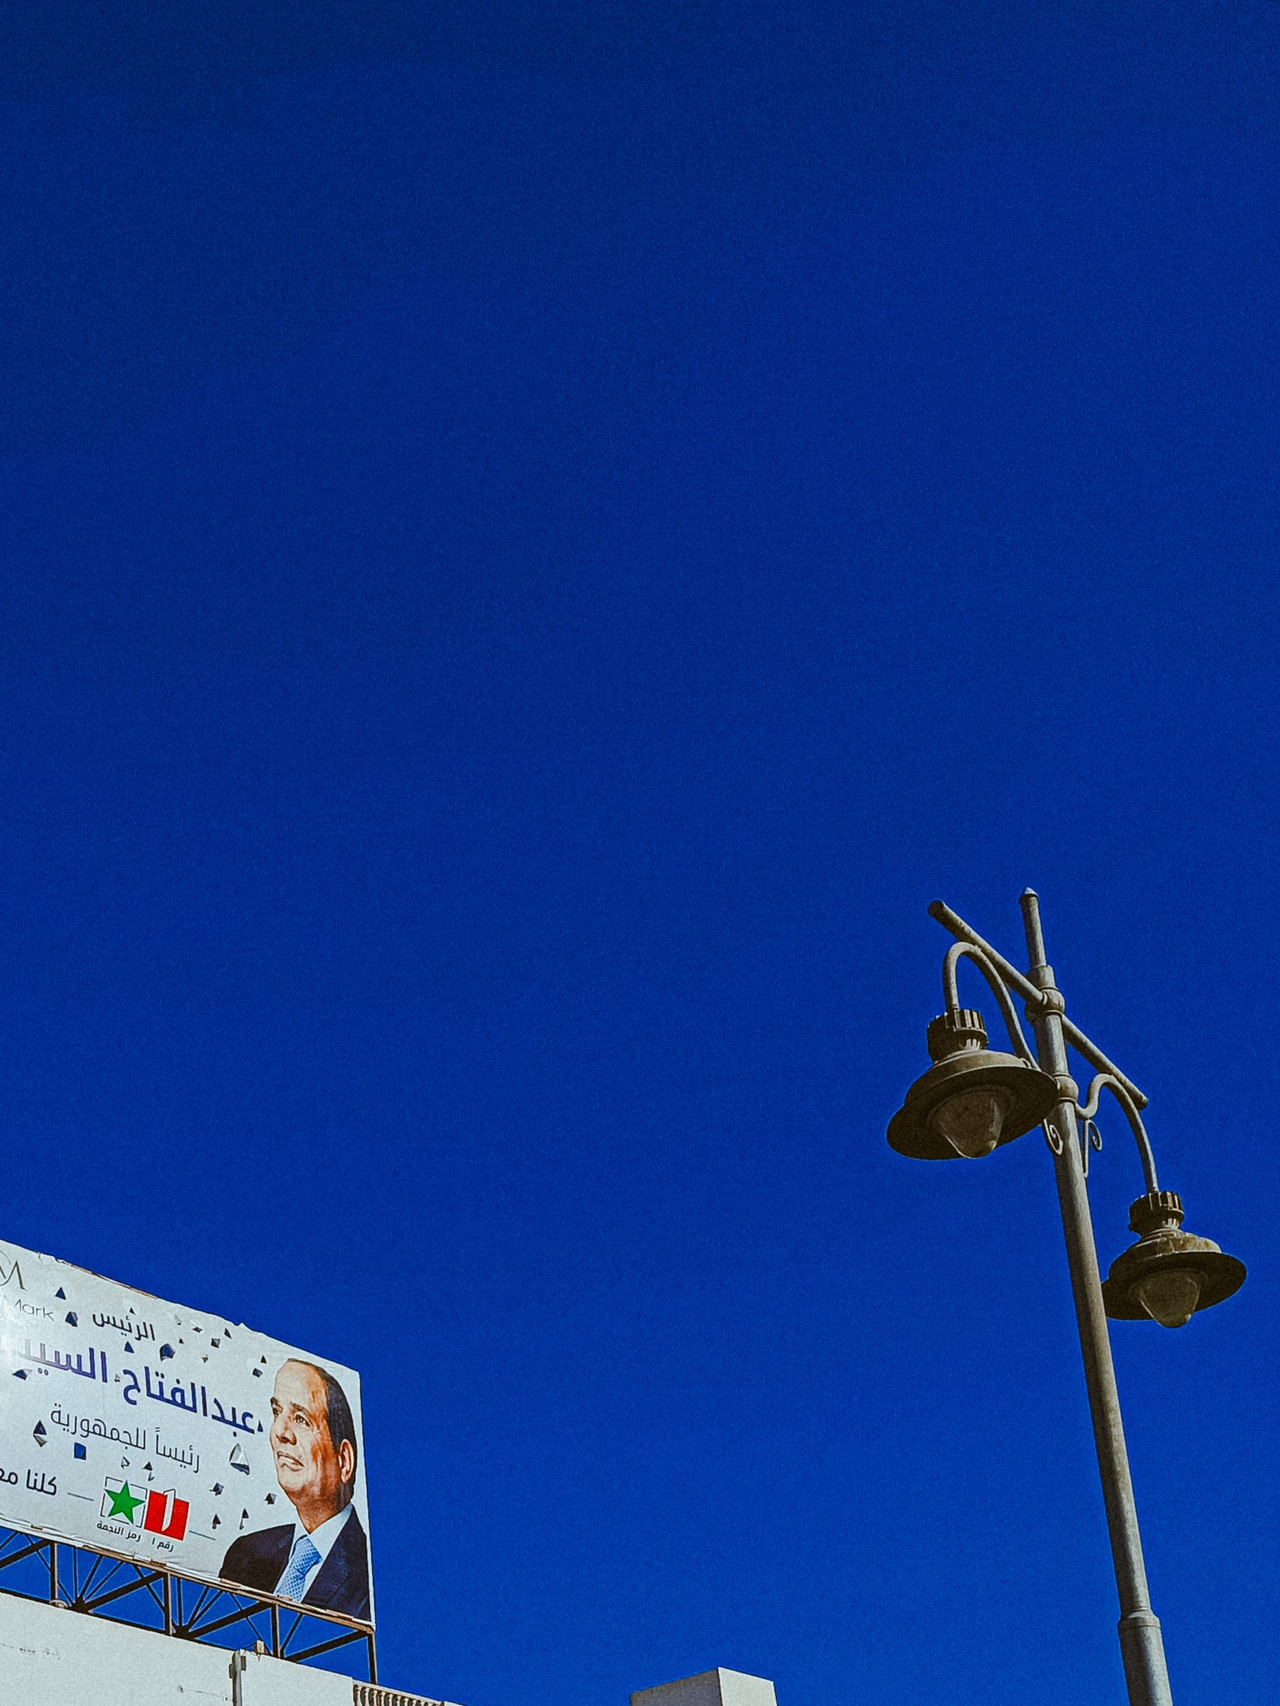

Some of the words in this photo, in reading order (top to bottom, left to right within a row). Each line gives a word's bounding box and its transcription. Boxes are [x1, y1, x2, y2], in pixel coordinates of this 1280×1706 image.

[93, 1311, 156, 1341] الرئيس
[50, 1403, 146, 1451] للجمهورية
[26, 1469, 58, 1496] كلنا
[96, 1519, 126, 1538] النجمة
